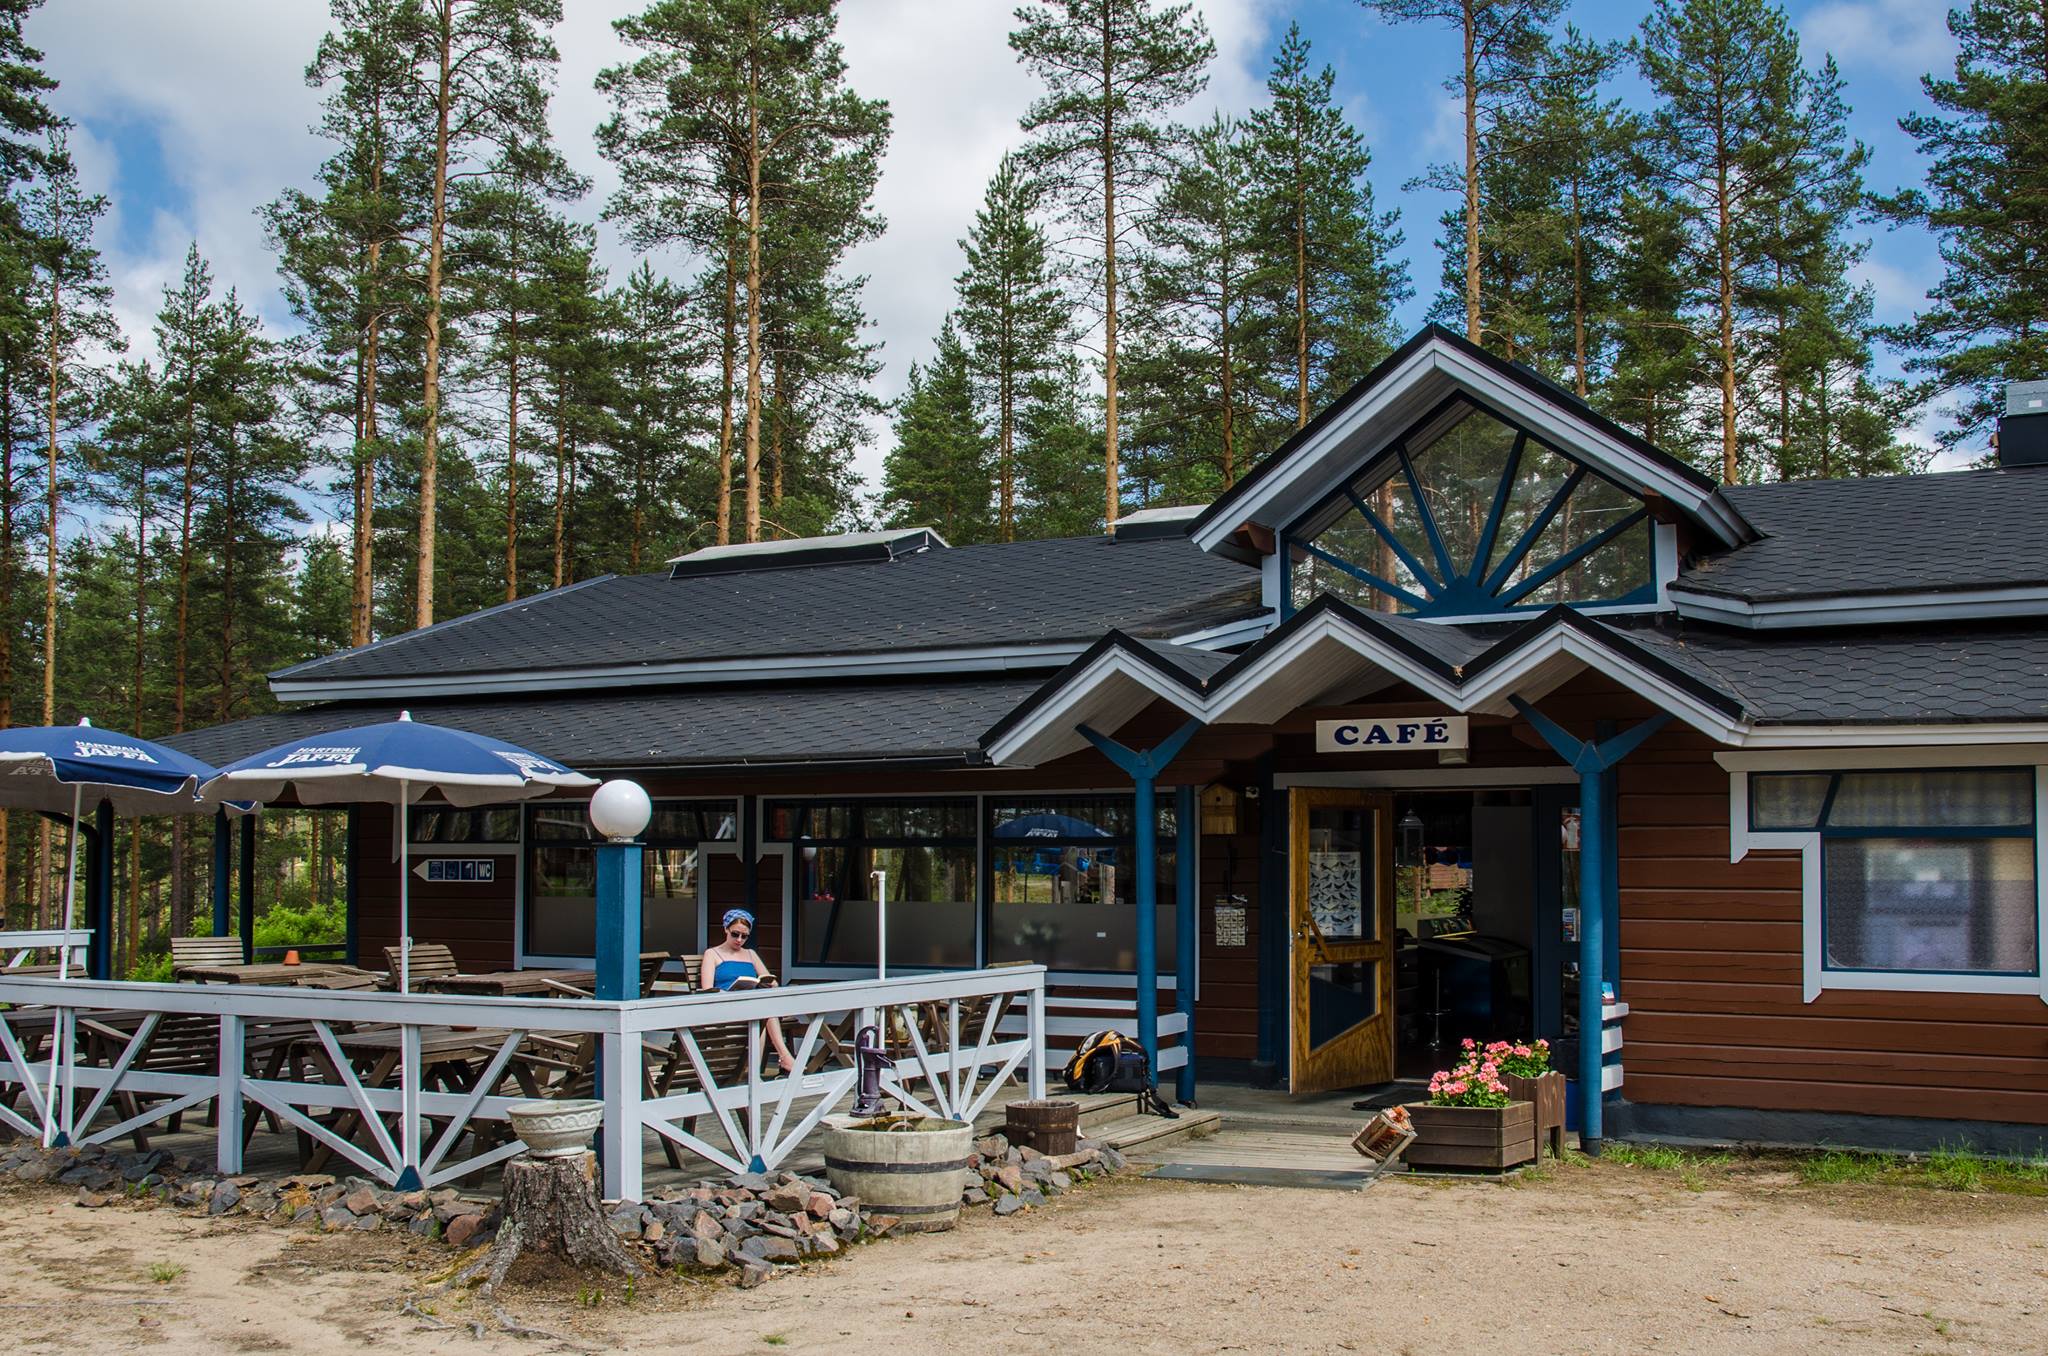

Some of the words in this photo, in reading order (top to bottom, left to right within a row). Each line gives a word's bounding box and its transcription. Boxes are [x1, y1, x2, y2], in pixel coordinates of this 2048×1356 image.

[1334, 718, 1449, 746] CAFÉ
[75, 740, 146, 754] HARTWALL
[296, 746, 361, 754] HARTWALL
[73, 746, 159, 764] JAFFA
[266, 753, 356, 768] JAFFA
[479, 863, 491, 878] WC
